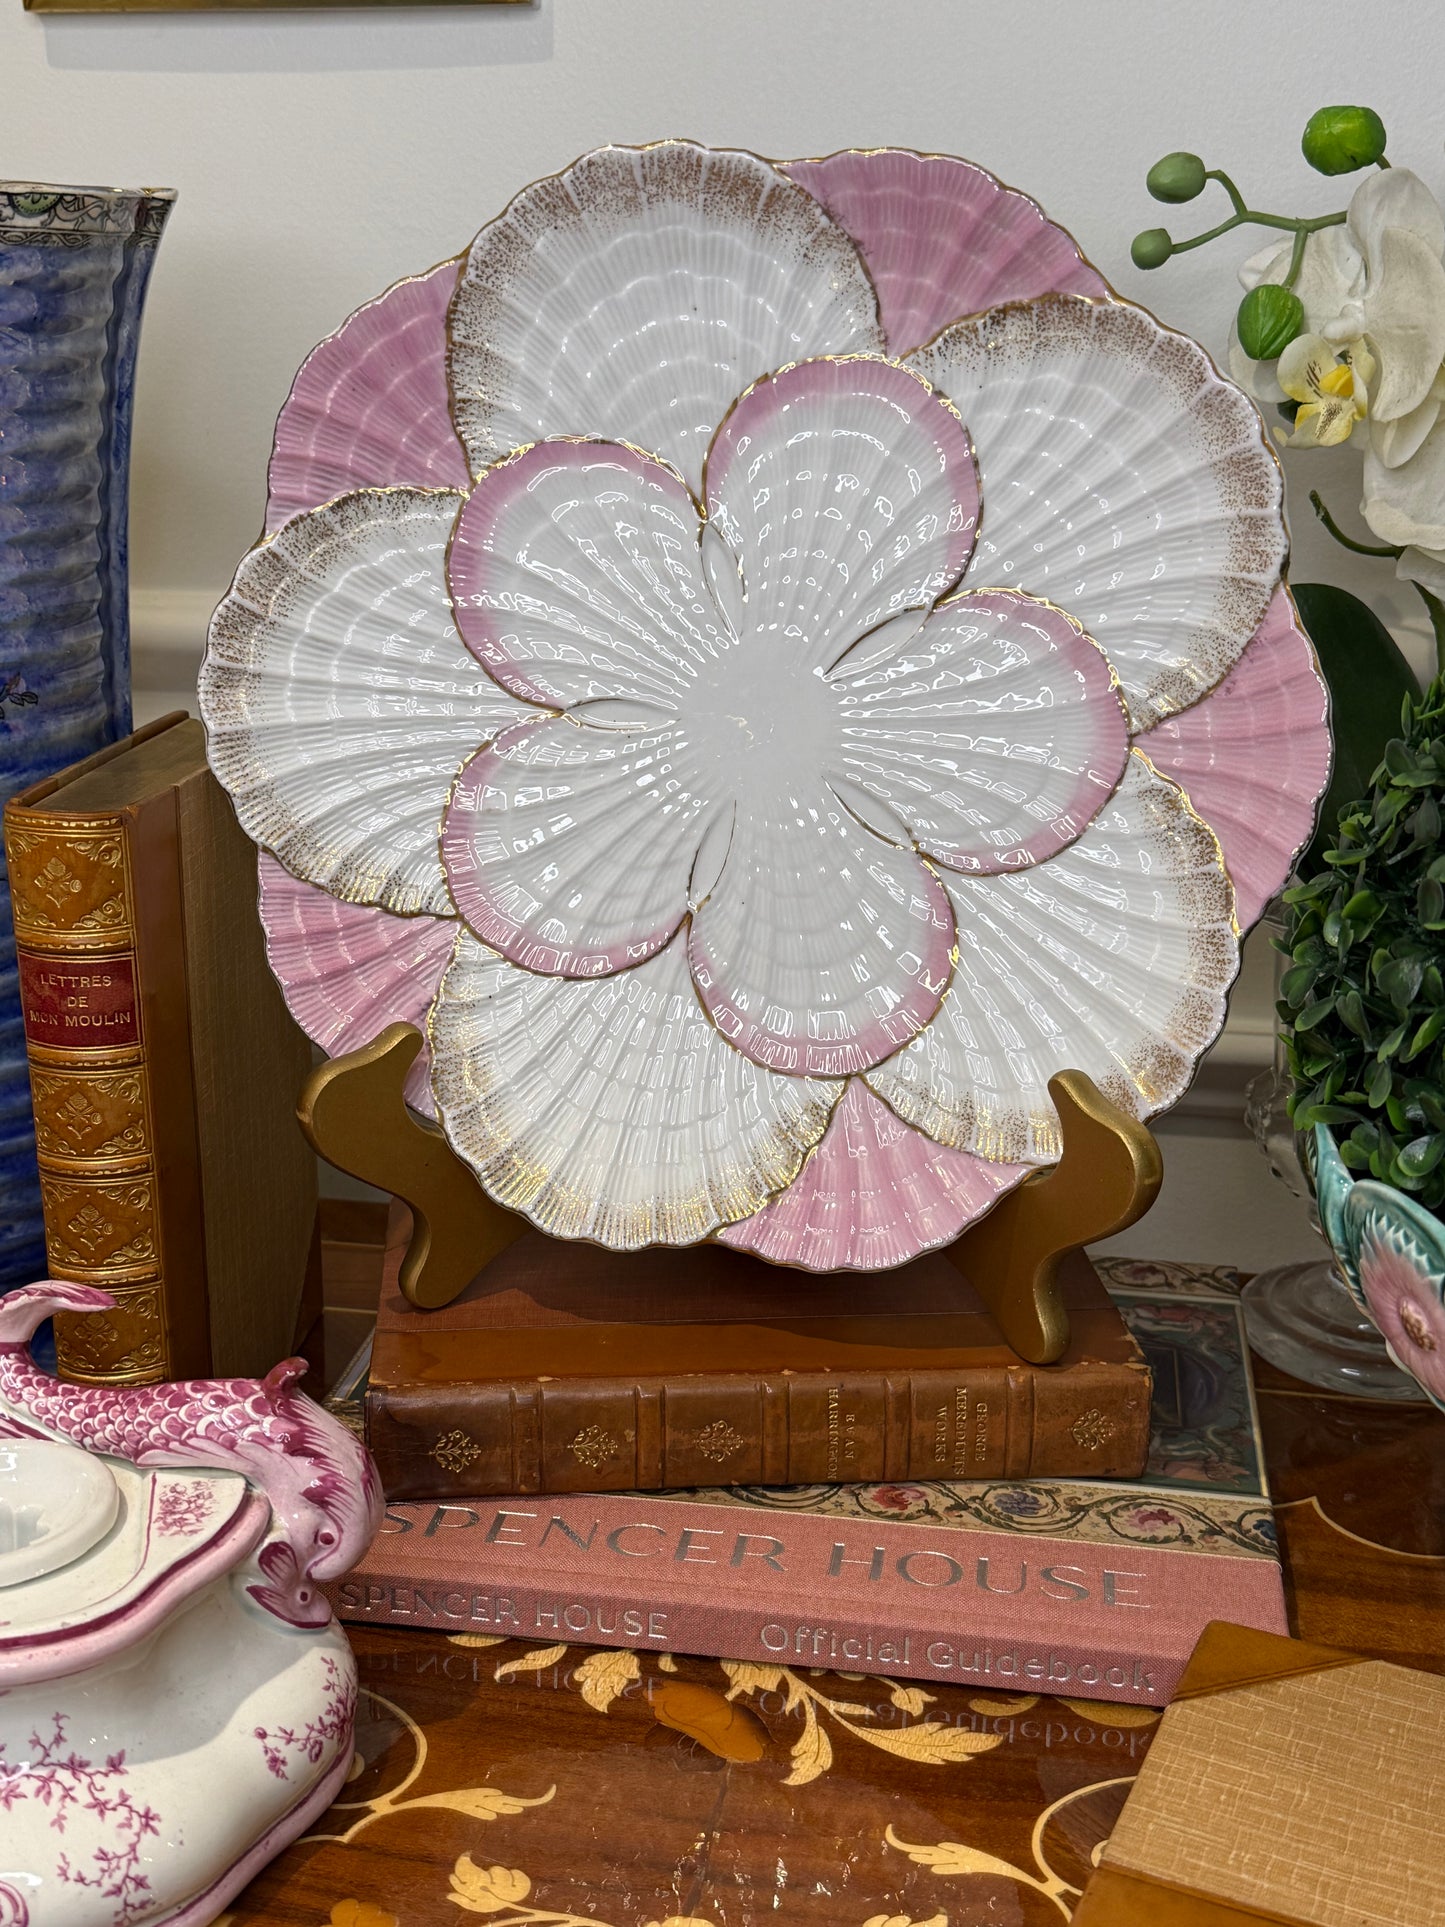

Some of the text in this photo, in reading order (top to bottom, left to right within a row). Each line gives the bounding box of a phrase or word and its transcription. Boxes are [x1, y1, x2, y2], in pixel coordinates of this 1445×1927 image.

[40, 973, 112, 988] LETTRES
[67, 996, 88, 1008] DE
[30, 1009, 131, 1027] MON MOULIN
[827, 1388, 839, 1480] HARRINGTON
[845, 1414, 855, 1460] EVAN
[935, 1405, 948, 1462] WORKS
[975, 1402, 988, 1462] GEORGE
[379, 1502, 1151, 1608] SPENCER HOUSE
[339, 1581, 667, 1640] SPENCER HOUSE
[760, 1623, 1154, 1692] Official Guidebook
